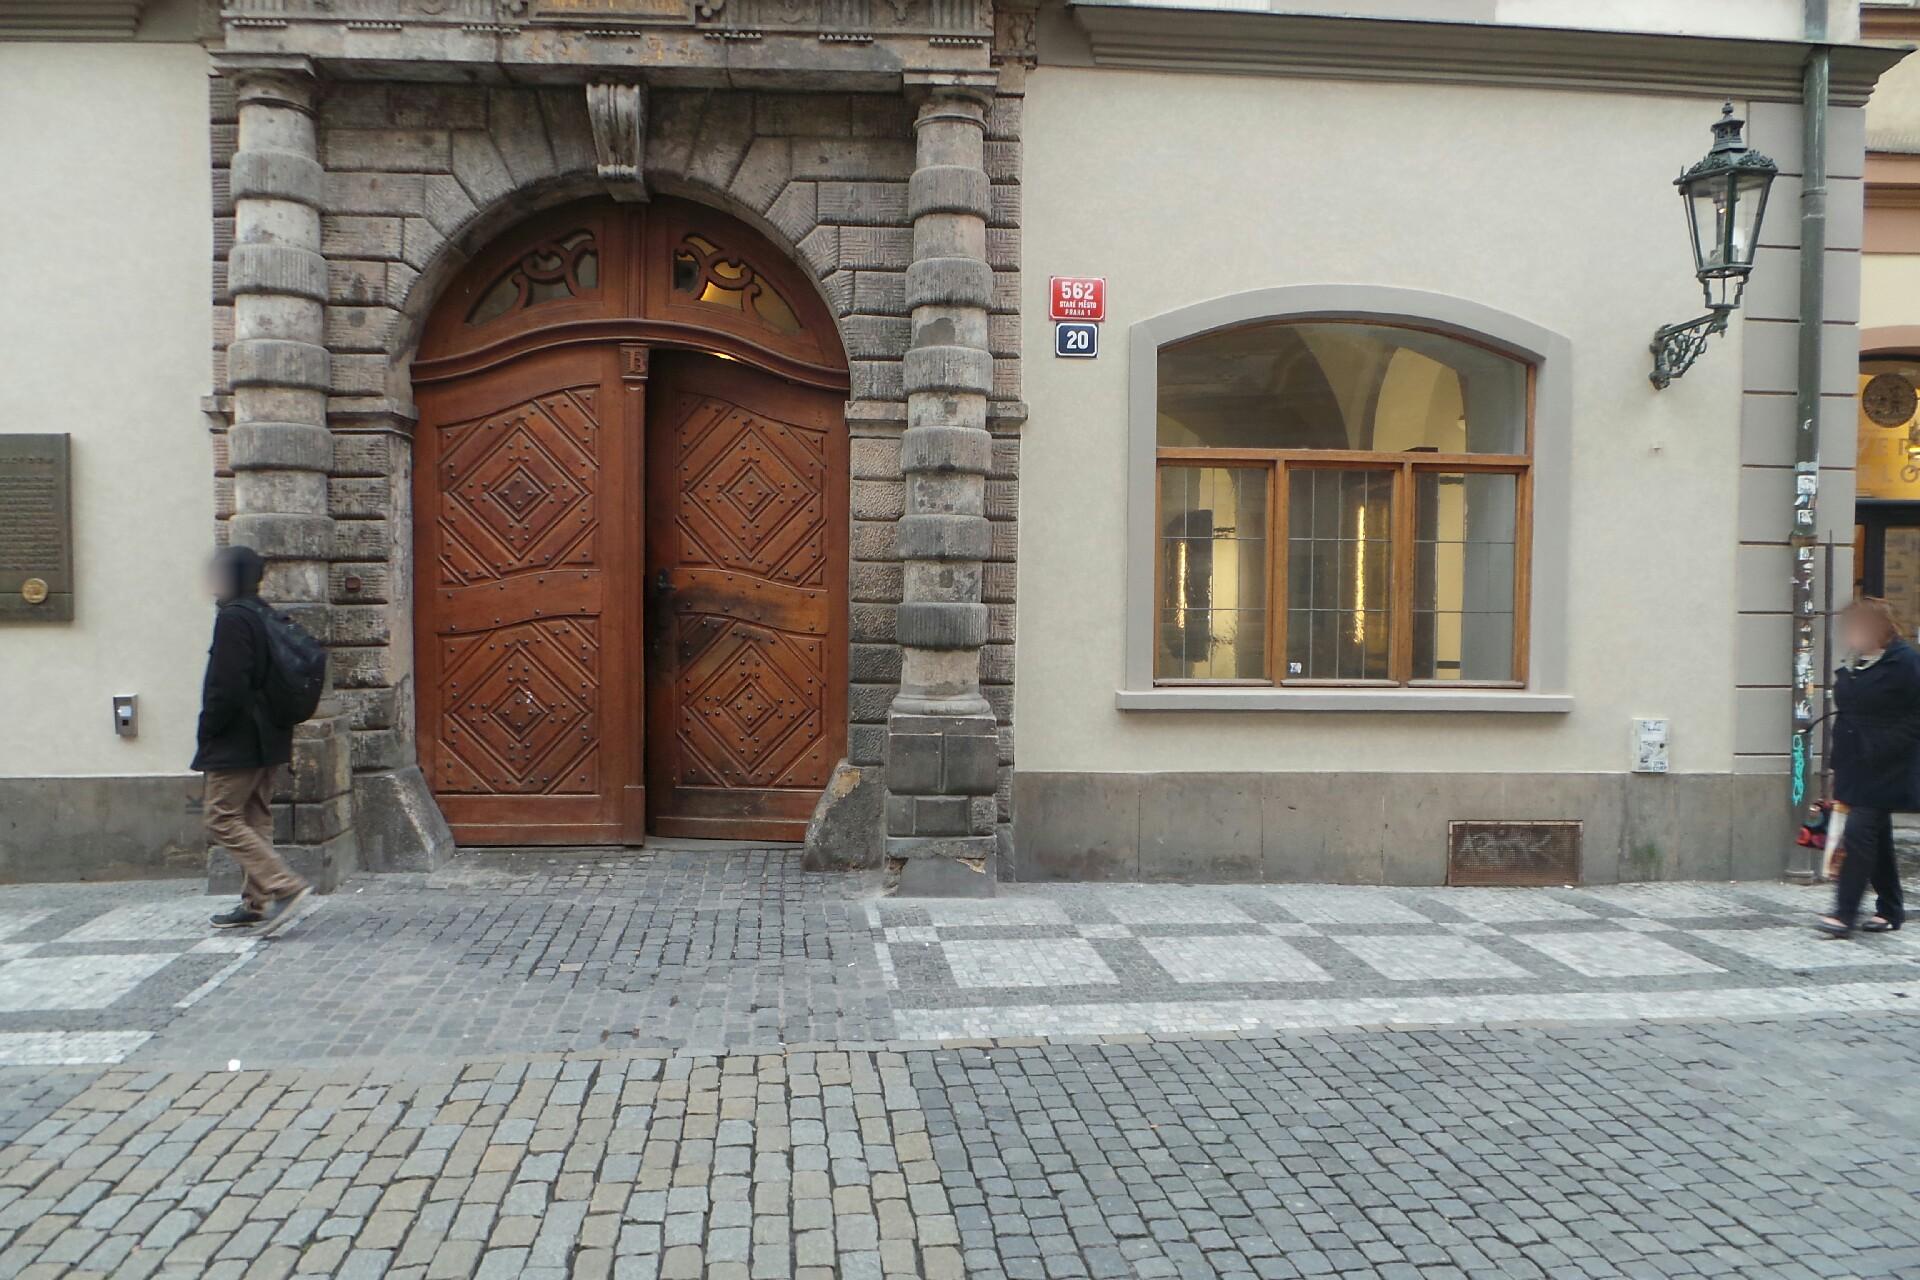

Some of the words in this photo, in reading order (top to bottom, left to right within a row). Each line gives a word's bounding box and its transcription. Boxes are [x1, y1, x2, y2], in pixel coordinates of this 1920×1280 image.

[1062, 281, 1094, 300] 562
[1060, 300, 1076, 308] STARÉ
[1079, 300, 1097, 309] MĚSTO
[1066, 330, 1089, 350] 20
